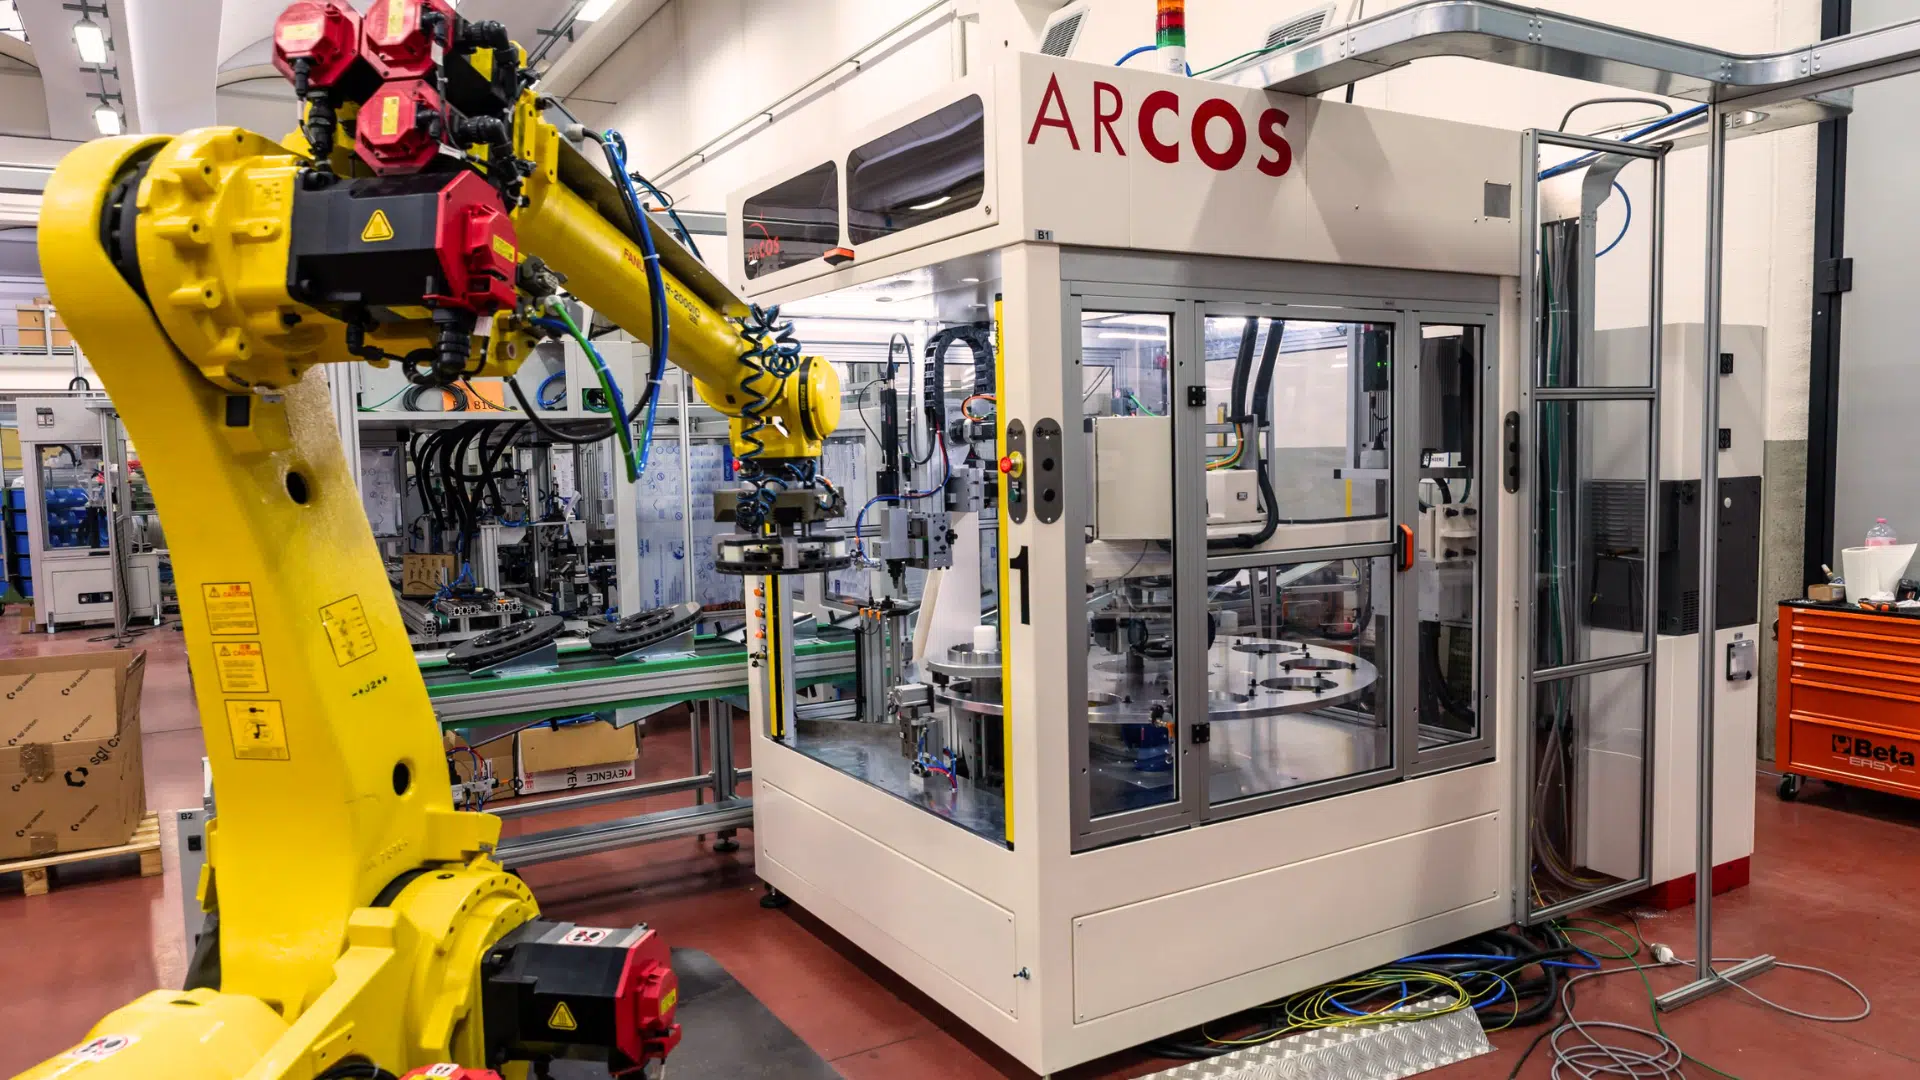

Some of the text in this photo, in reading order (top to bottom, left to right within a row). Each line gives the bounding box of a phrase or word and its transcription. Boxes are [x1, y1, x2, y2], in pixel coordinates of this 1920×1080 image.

[1028, 72, 1292, 177] ARCOS
[1038, 230, 1049, 240] B1
[748, 236, 780, 262] ARCOS
[624, 248, 645, 273] FANU
[1010, 545, 1030, 625] 1
[24, 719, 39, 733] carbon
[78, 714, 92, 728] carbon
[90, 745, 111, 765] sgl
[1854, 738, 1915, 767] Beta
[1849, 756, 1897, 772] EASY
[587, 768, 632, 783] KEYENCE
[180, 812, 193, 820] B2
